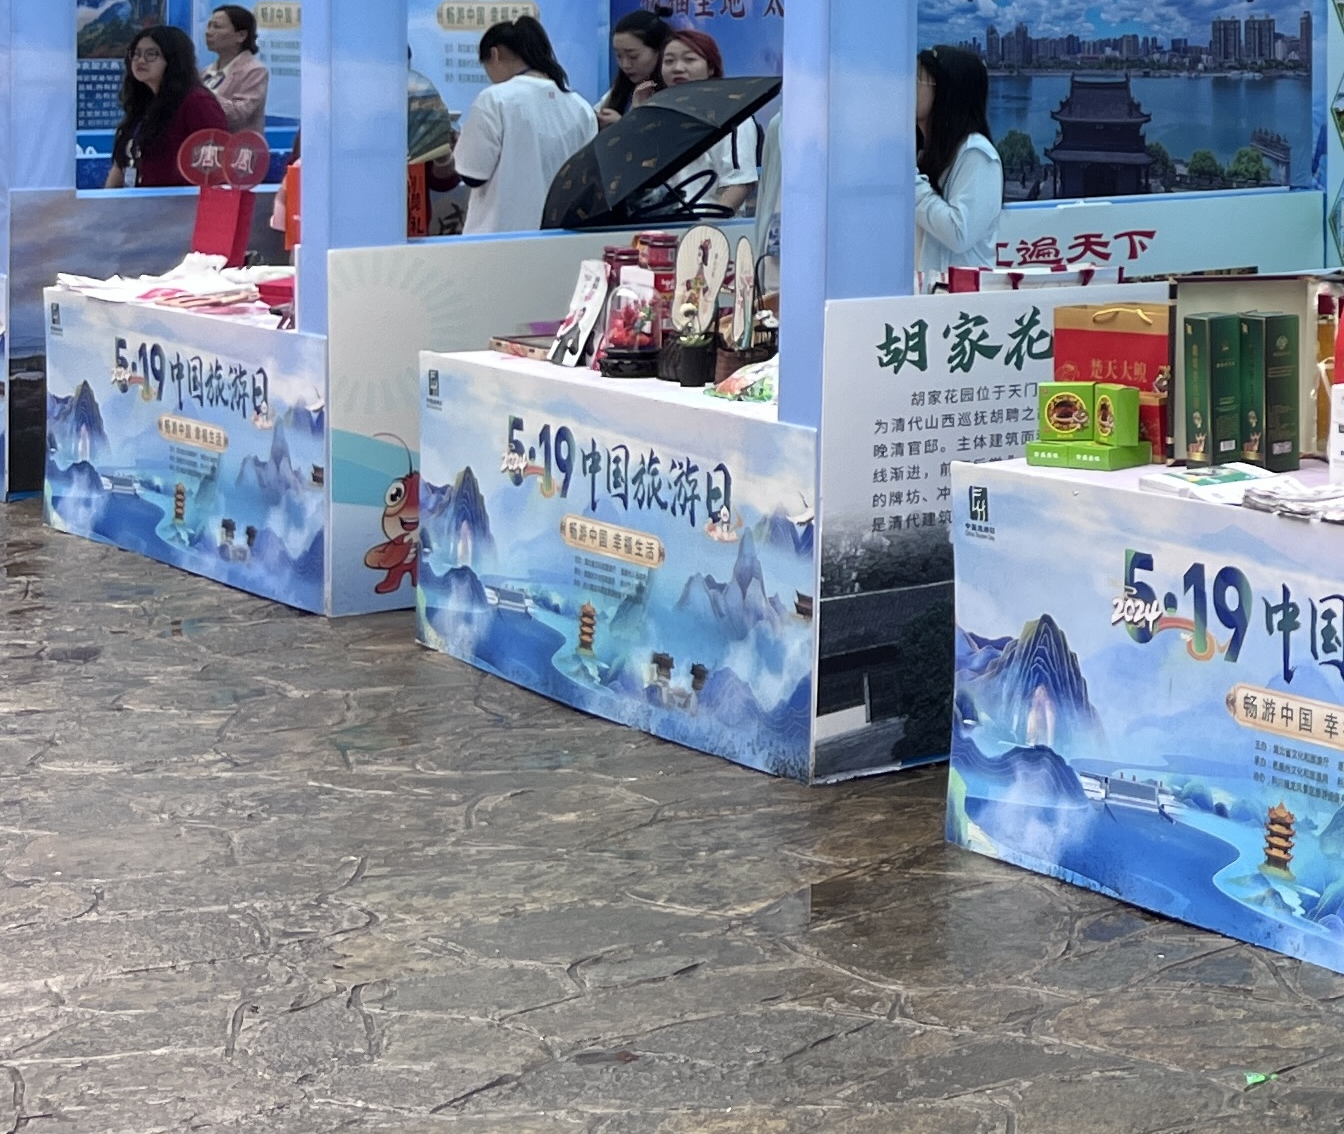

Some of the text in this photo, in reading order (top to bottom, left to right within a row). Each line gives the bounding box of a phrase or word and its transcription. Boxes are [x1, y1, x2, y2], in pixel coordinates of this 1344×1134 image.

[875, 306, 1054, 374] 胡家花
[911, 382, 1038, 406] 胡家花园位于天门
[874, 406, 1040, 435] 为清代山西巡抚胡聘之
[873, 429, 1040, 459] 晚清官邸。主体建筑面
[1111, 597, 1164, 631] 2024
[1242, 693, 1313, 733] 畅游中国
